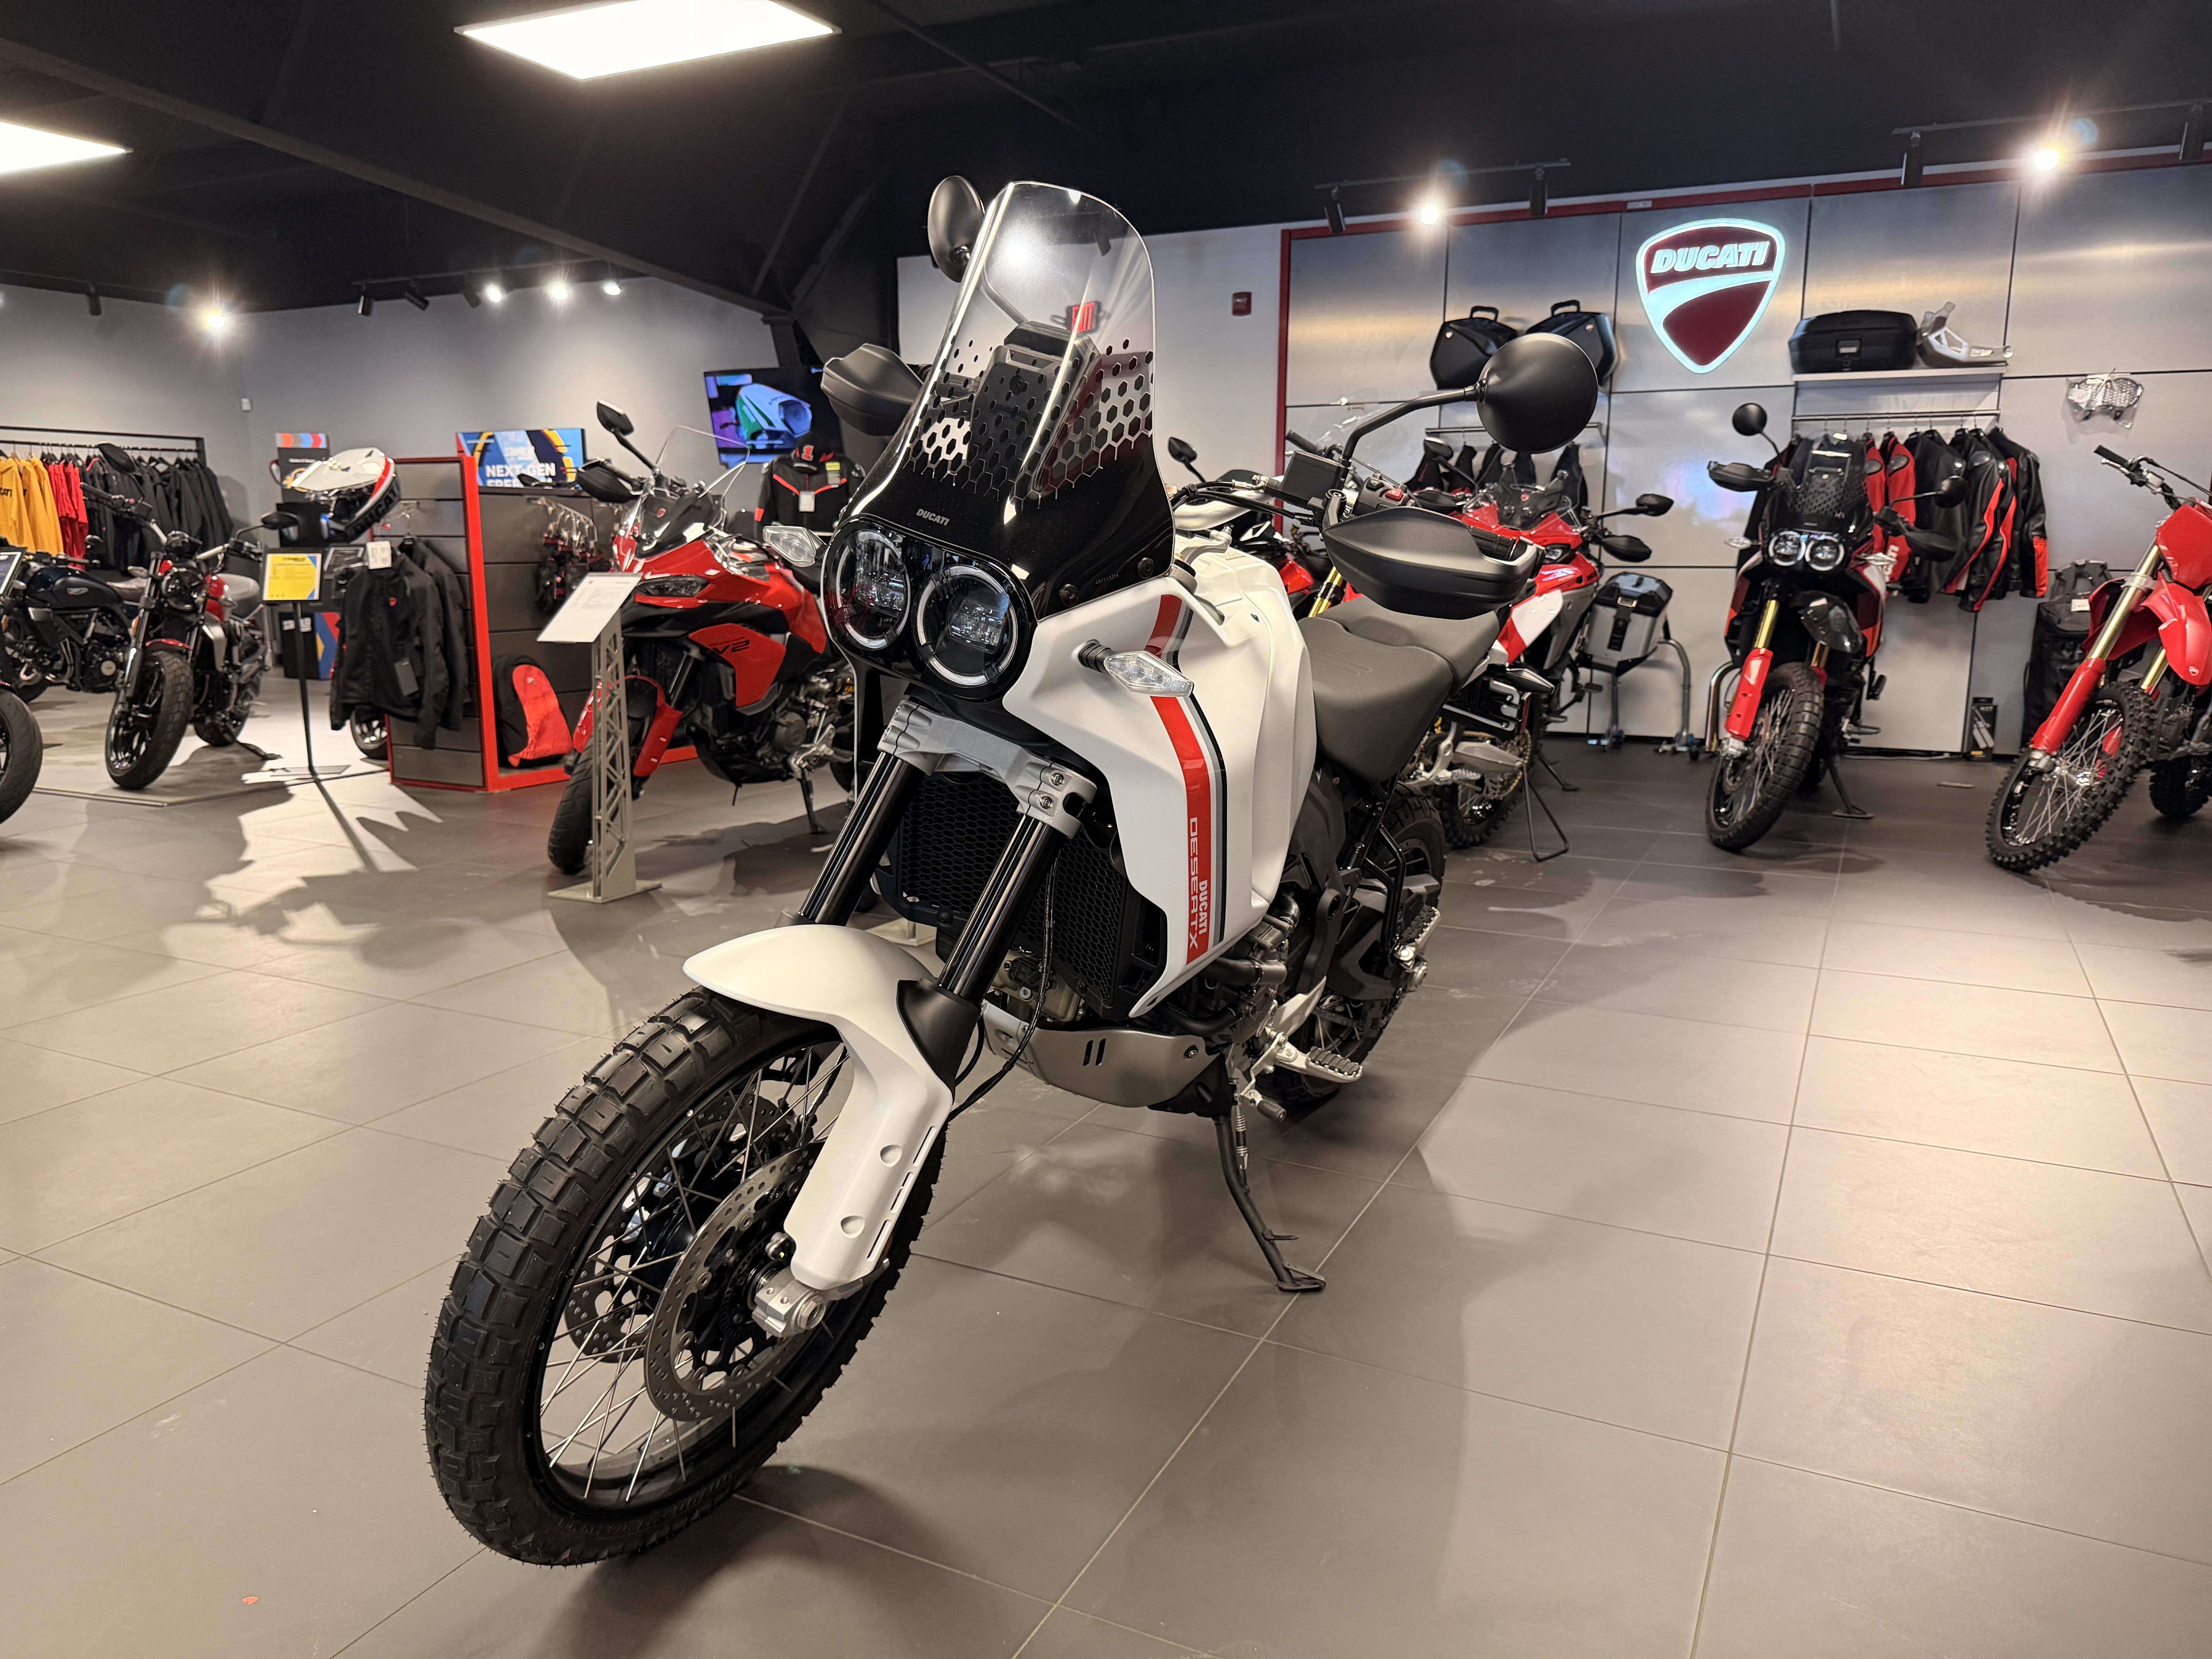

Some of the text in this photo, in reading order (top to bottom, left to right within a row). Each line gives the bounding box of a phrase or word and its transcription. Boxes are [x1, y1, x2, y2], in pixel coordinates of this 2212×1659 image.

[1650, 241, 1770, 274] DUCATI
[916, 508, 950, 526] DUCATI
[713, 640, 750, 654] V2
[1199, 879, 1208, 935] DUCATI
